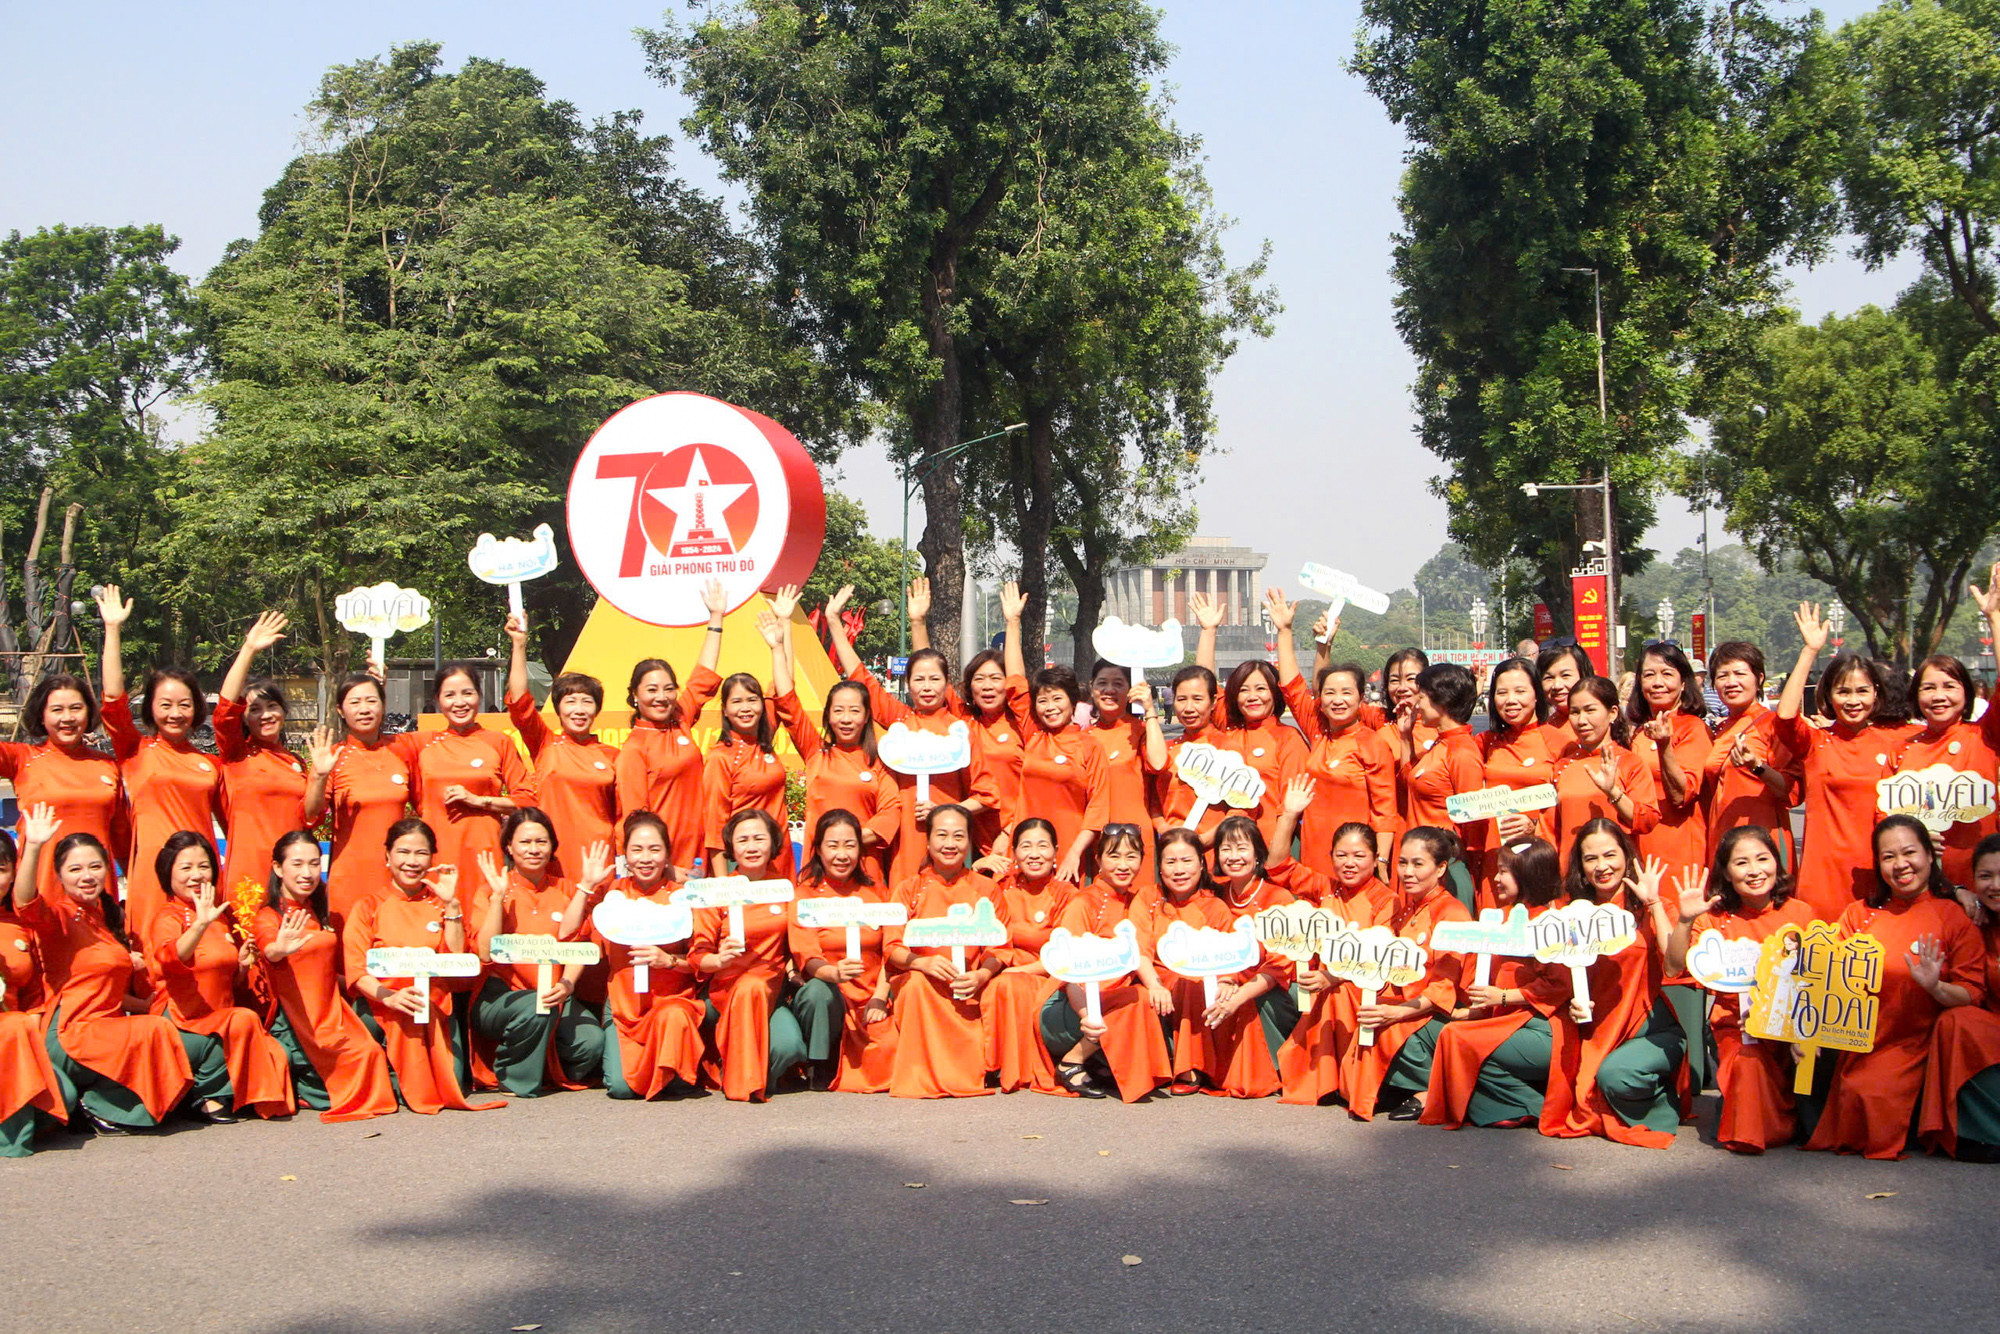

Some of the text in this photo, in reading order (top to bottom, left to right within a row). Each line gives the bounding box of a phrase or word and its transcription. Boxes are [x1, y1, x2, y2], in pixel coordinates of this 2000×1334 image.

[650, 562, 671, 577] GIẢI
[716, 557, 736, 573] THỦ
[740, 557, 755, 572] ĐÔ
[1882, 775, 1988, 810] TÔI YÊU
[1527, 914, 1567, 951] TÔI
[1577, 908, 1628, 945] YÊU
[1325, 931, 1361, 963] TÔI
[1374, 939, 1421, 972] YÊU
[1799, 925, 1880, 997] LỄ HỘI
[1790, 982, 1820, 1038] ÁO
[1848, 1038, 1868, 1047] 2024
